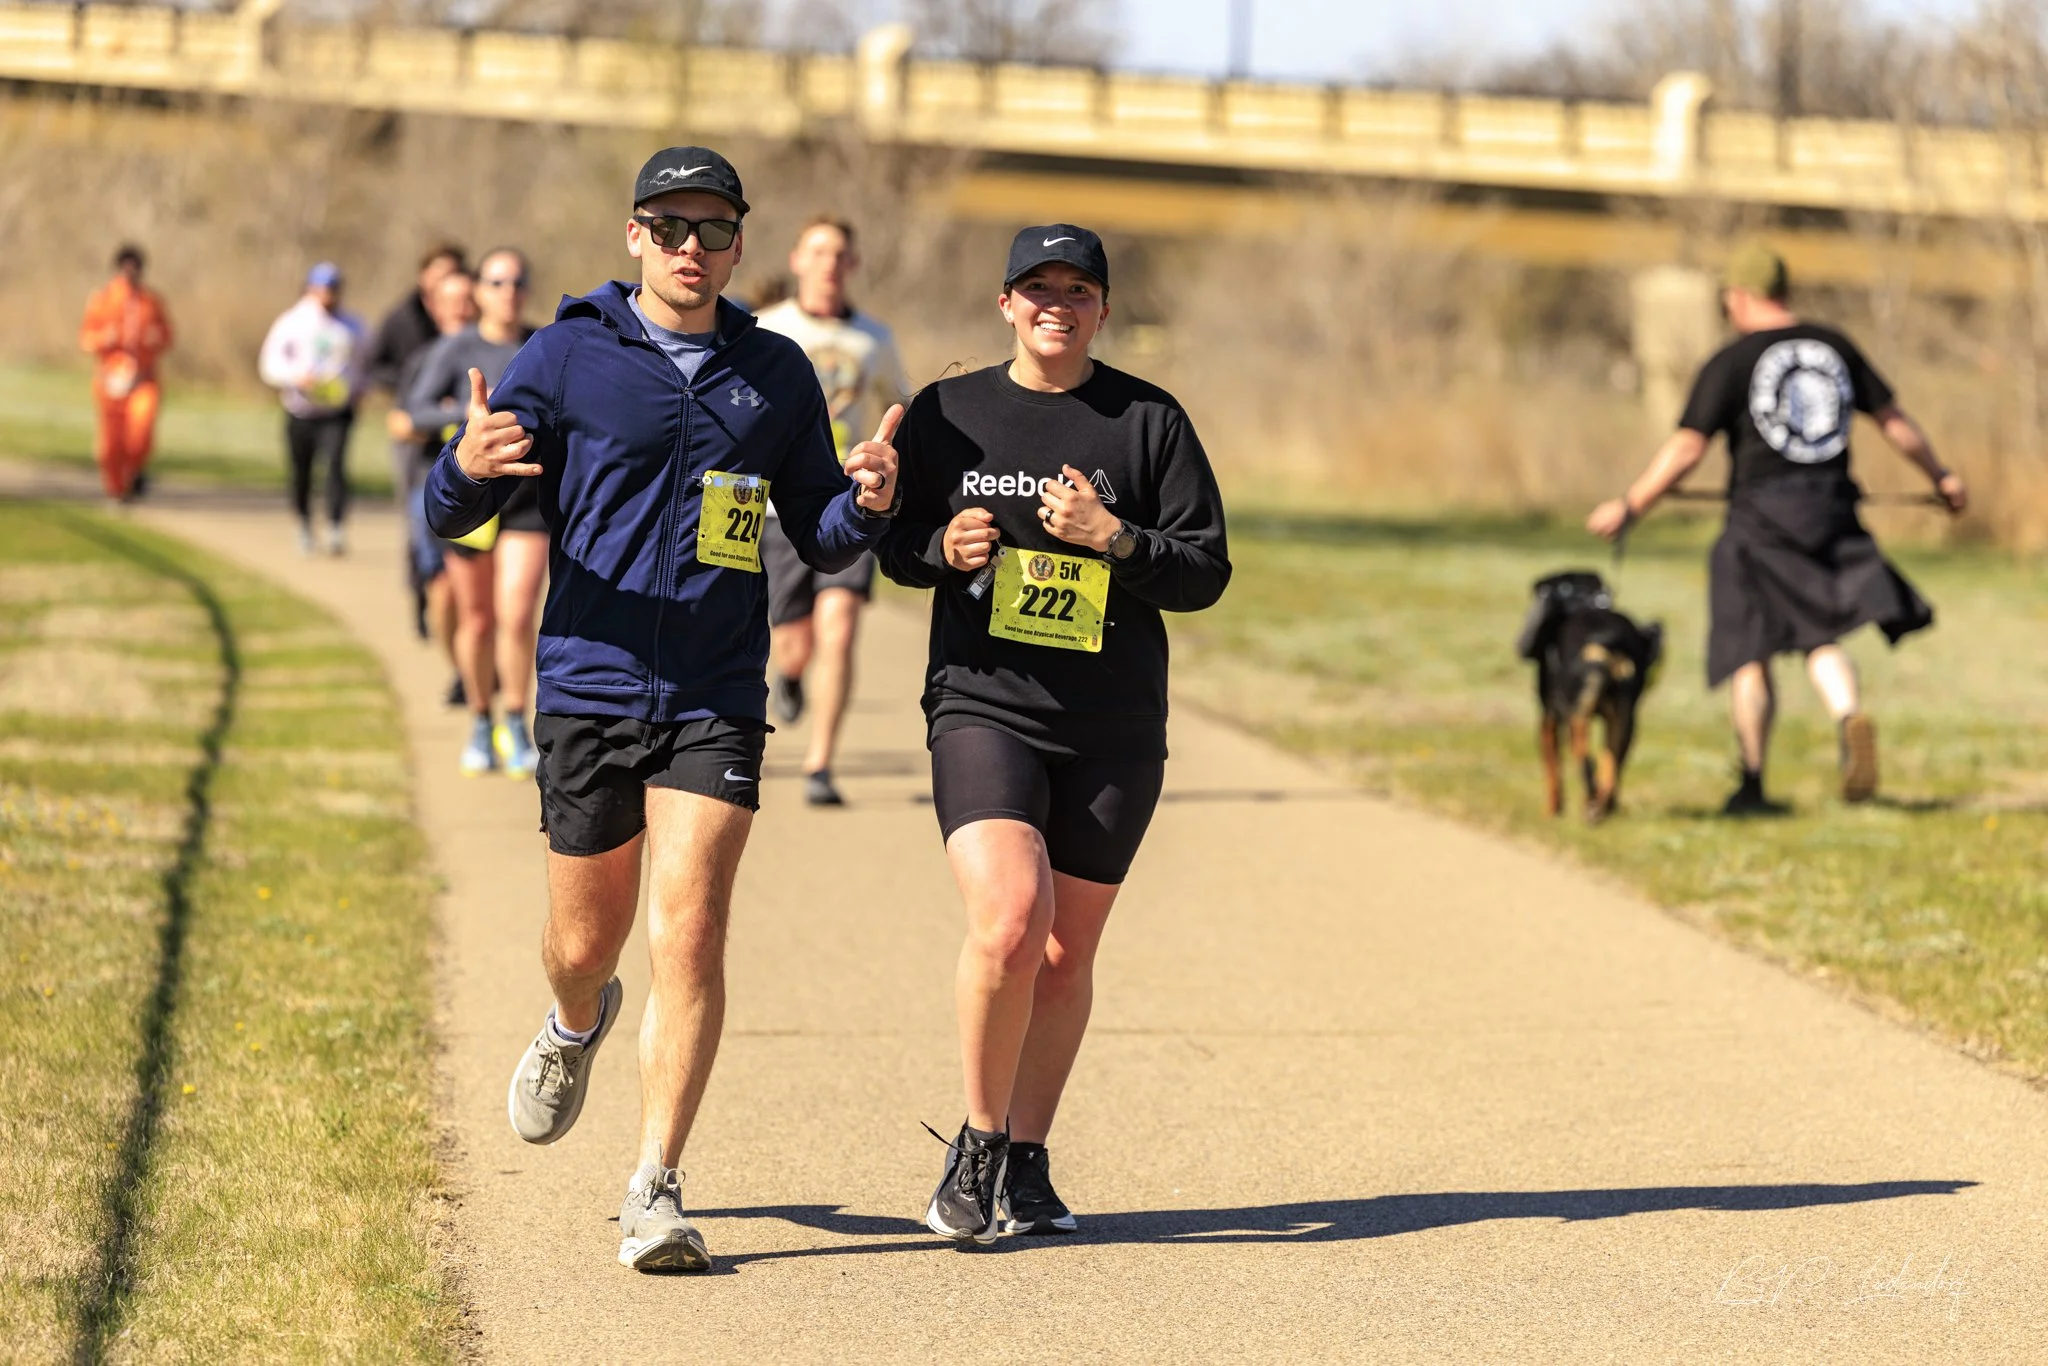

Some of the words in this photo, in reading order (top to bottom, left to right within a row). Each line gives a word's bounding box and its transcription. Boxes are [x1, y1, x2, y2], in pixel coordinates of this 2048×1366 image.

[754, 485, 766, 504] 5K
[725, 507, 761, 544] 224
[709, 550, 721, 558] Good
[1059, 561, 1082, 581] 5K
[1019, 584, 1077, 622] 222
[1004, 624, 1016, 632] Good
[1034, 630, 1054, 639] Atypical
[1055, 633, 1077, 642] Beverage
